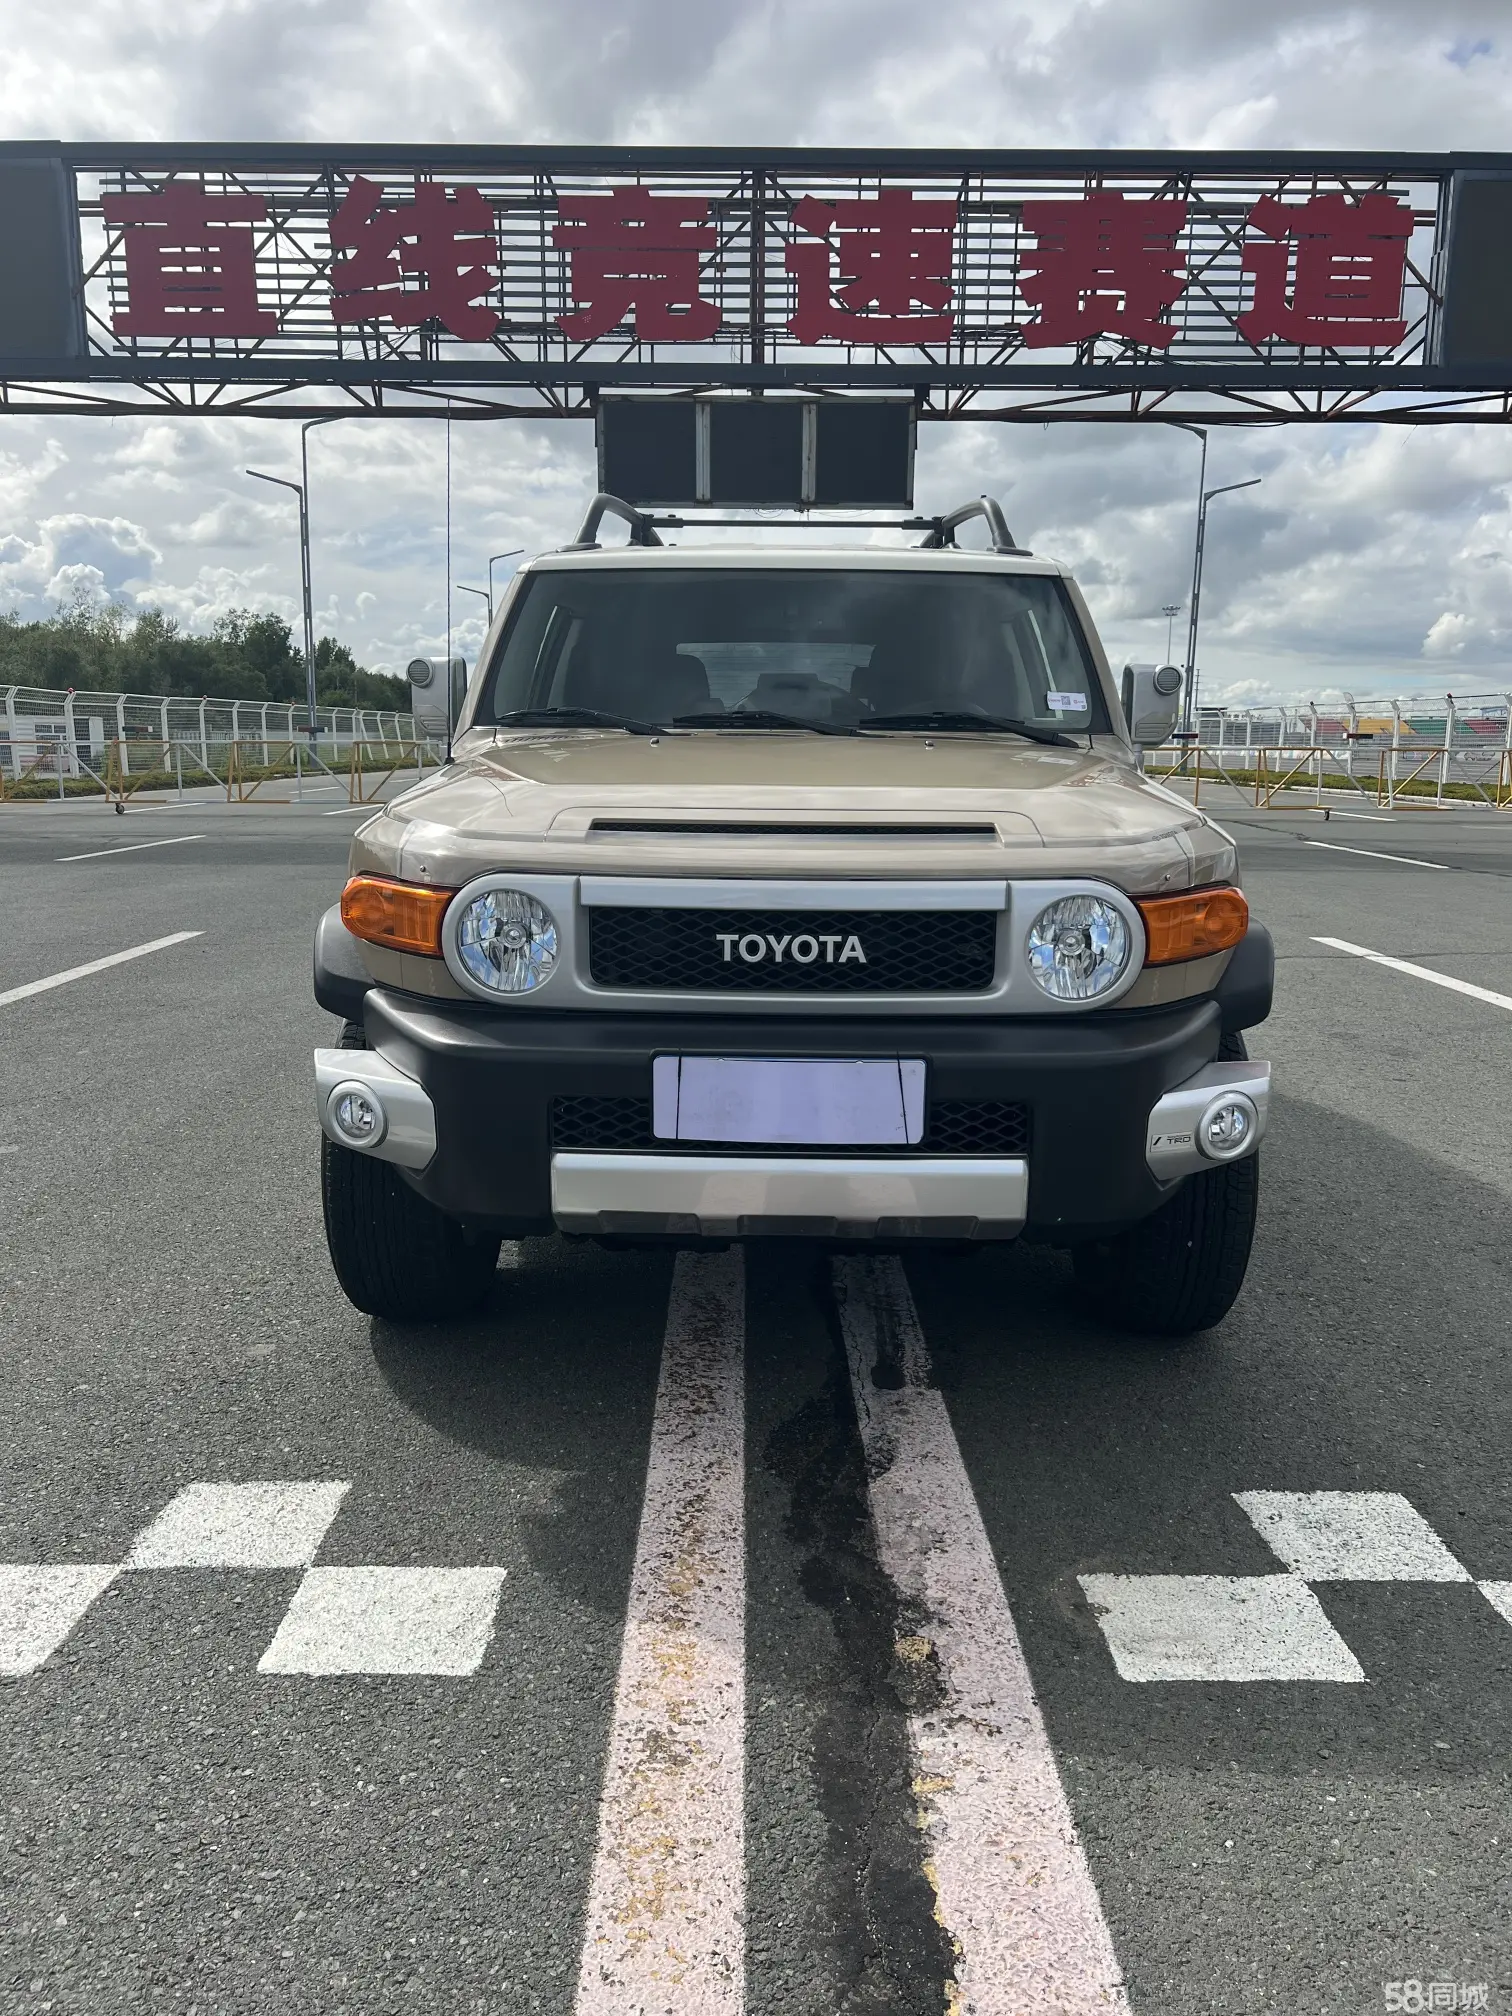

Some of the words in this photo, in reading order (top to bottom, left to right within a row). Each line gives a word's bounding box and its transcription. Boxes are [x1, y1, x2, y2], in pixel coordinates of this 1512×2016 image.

[102, 175, 1415, 349] 直线竞速赛道
[716, 934, 867, 963] TOYOTA
[1166, 1136, 1191, 1144] TRD
